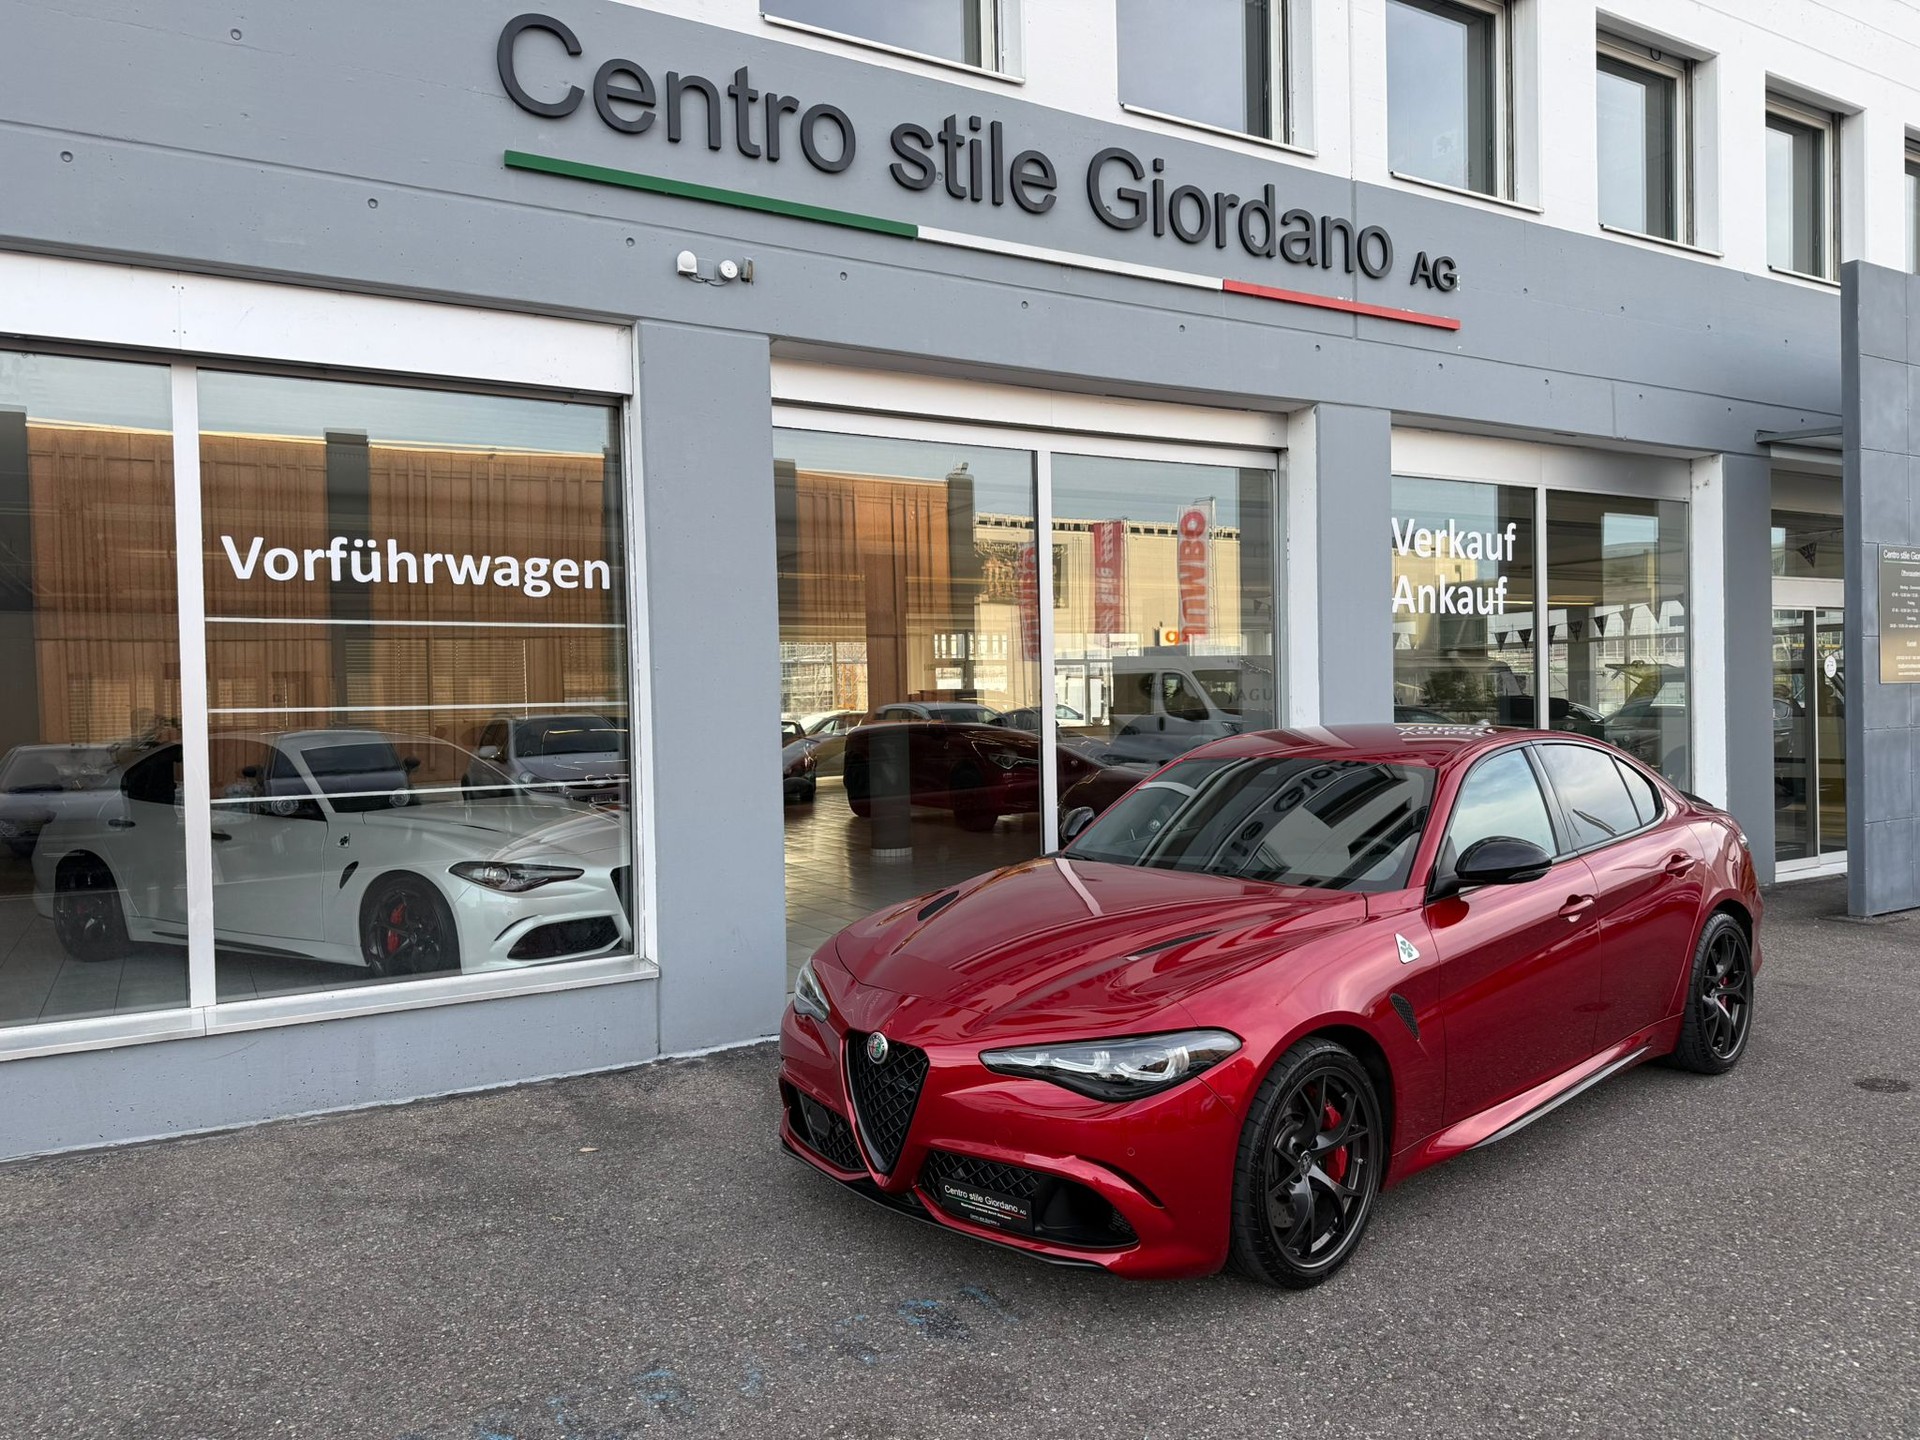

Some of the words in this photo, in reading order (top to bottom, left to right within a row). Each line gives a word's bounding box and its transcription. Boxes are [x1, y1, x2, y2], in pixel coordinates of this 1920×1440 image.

[497, 13, 856, 174] Centro
[889, 113, 1057, 214] stile
[1086, 147, 1394, 279] Giordano
[1410, 251, 1458, 292] AG
[1391, 517, 1516, 561] Verkauf
[220, 535, 611, 597] Vorführwagen
[1391, 574, 1508, 615] Ankauf
[944, 1184, 968, 1198] Centro
[968, 1192, 984, 1203] stile
[984, 1196, 1018, 1212] Giordano
